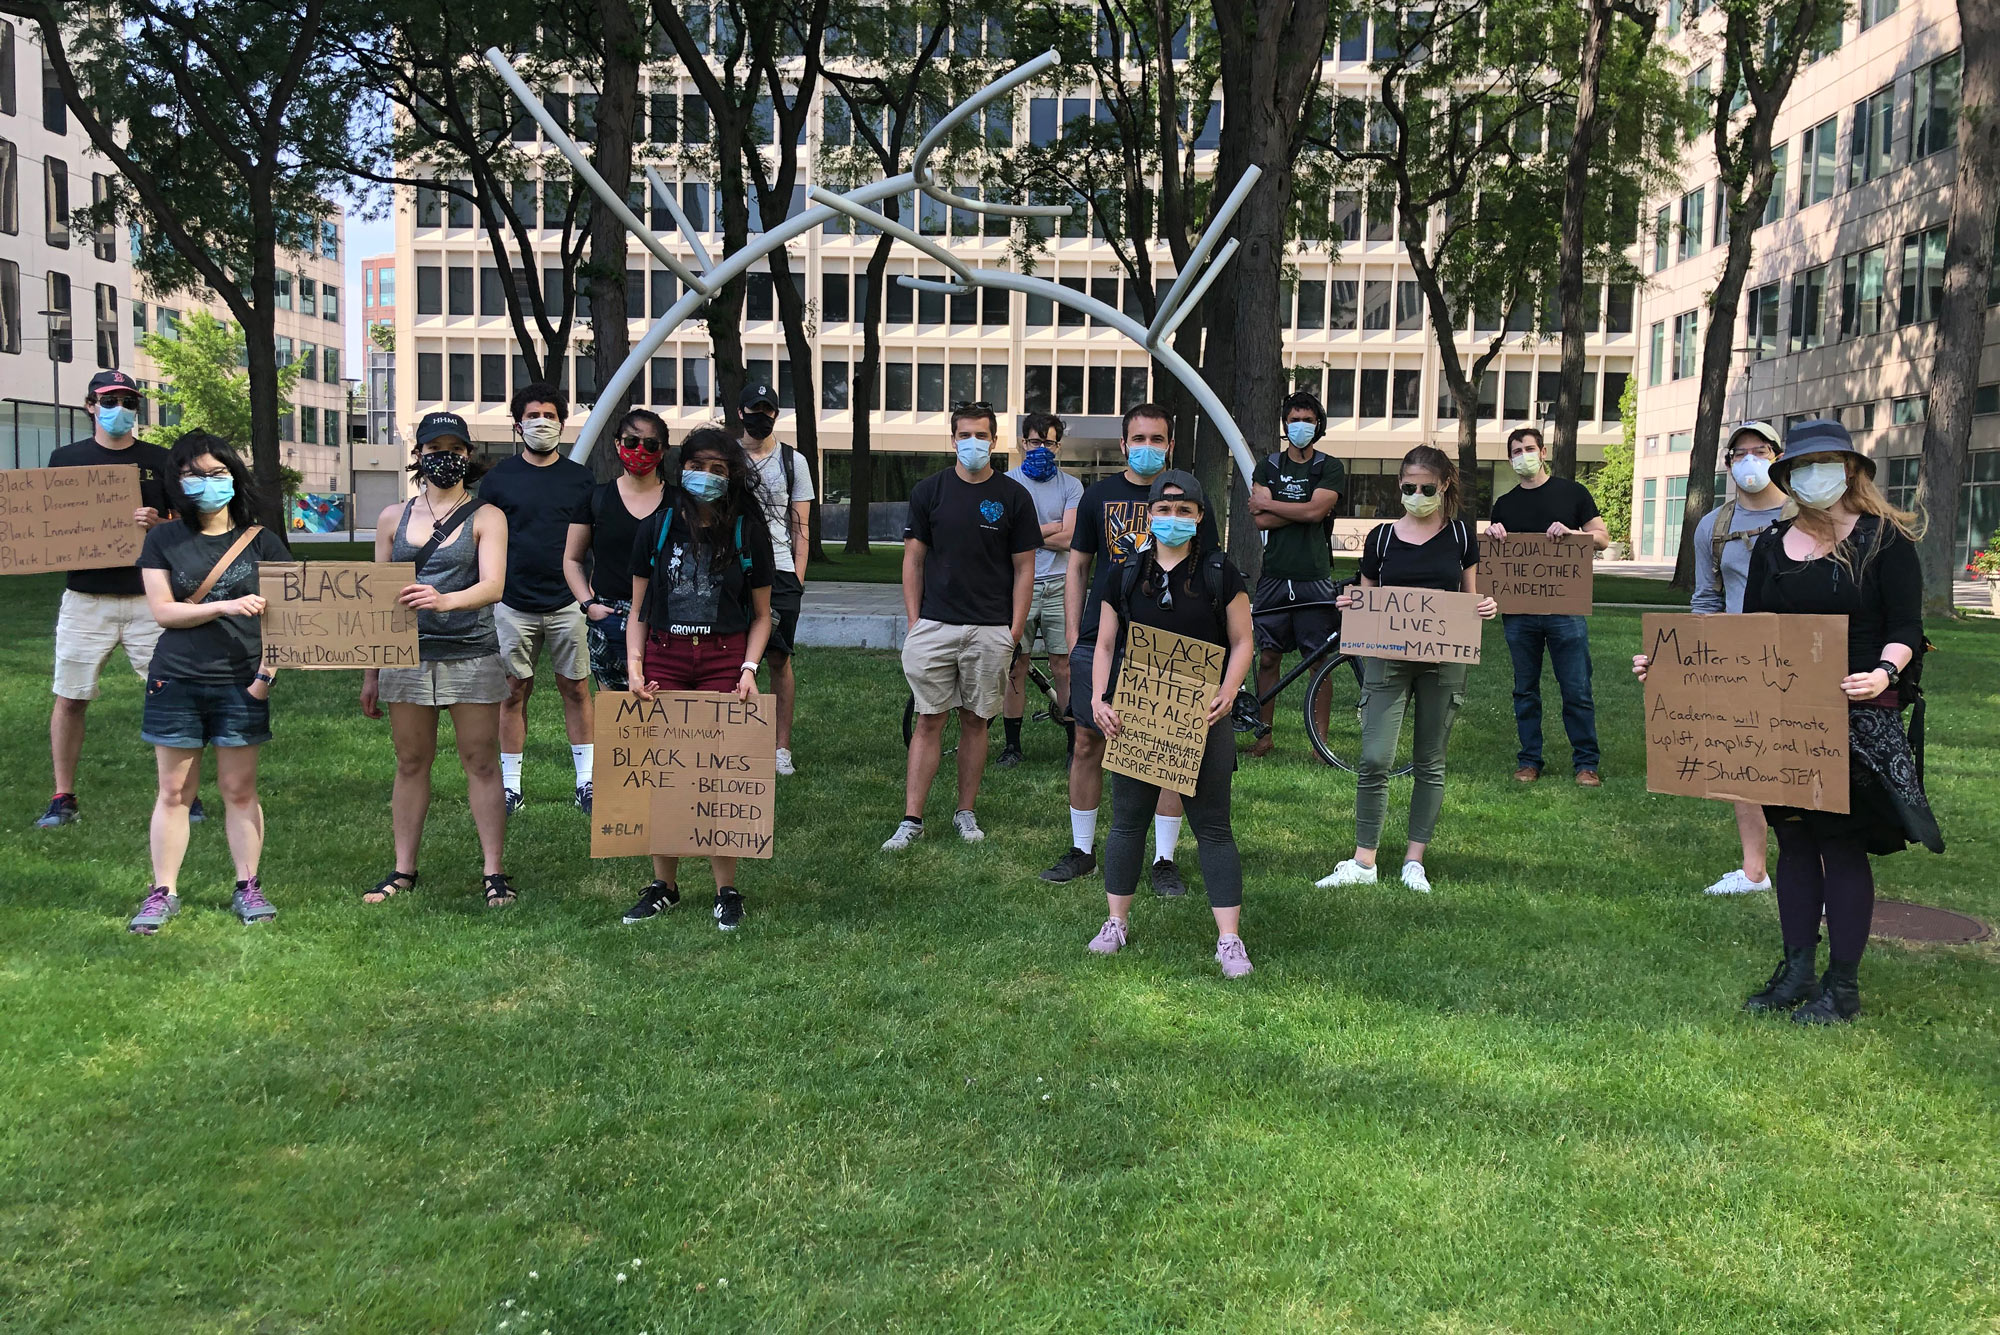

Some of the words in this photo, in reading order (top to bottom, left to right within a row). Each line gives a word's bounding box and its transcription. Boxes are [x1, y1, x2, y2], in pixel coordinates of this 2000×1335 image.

[43, 471, 80, 490] Voices
[87, 469, 127, 487] Matter
[1, 545, 38, 569] Black
[45, 547, 72, 566] Lives
[1478, 540, 1588, 558] INEQUALITY
[284, 560, 373, 603] BLACK
[1476, 560, 1493, 575] IS
[1500, 562, 1529, 577] THE
[1533, 563, 1582, 579] OTHER
[1492, 580, 1566, 597] PANDEMIC
[1350, 589, 1436, 614] BLACK
[266, 611, 328, 637] LIVES
[337, 609, 418, 638] MATTER
[670, 624, 711, 636] GROWTH
[1390, 616, 1447, 636] LIVES
[1131, 626, 1220, 671] BLACK
[1404, 640, 1481, 660] MATTER
[1650, 628, 1728, 666] Matter
[1736, 654, 1750, 665] is
[1758, 645, 1793, 668] the
[1129, 650, 1206, 688] LIVES
[1122, 672, 1206, 711] MATTER
[615, 697, 768, 726] MATTER
[1118, 692, 1159, 716] THEY
[1163, 705, 1204, 730] ALSO
[1651, 693, 1727, 722] Academia
[1733, 710, 1760, 726] will
[618, 725, 630, 739] IS
[636, 726, 659, 738] THE
[663, 727, 725, 742] MINIMUM
[1114, 709, 1157, 729] TEACH
[1167, 725, 1203, 744] LEAD
[1115, 725, 1152, 746] REATE
[1773, 738, 1798, 753] and
[613, 747, 686, 769] BLACK
[696, 752, 751, 772] LIVES
[1106, 752, 1153, 777] INSPIRE
[623, 770, 676, 788] ARE
[698, 777, 766, 795] BELOVED
[696, 802, 762, 820] NEEDED
[601, 823, 644, 836] #BLM
[694, 828, 773, 854] WORTHY
